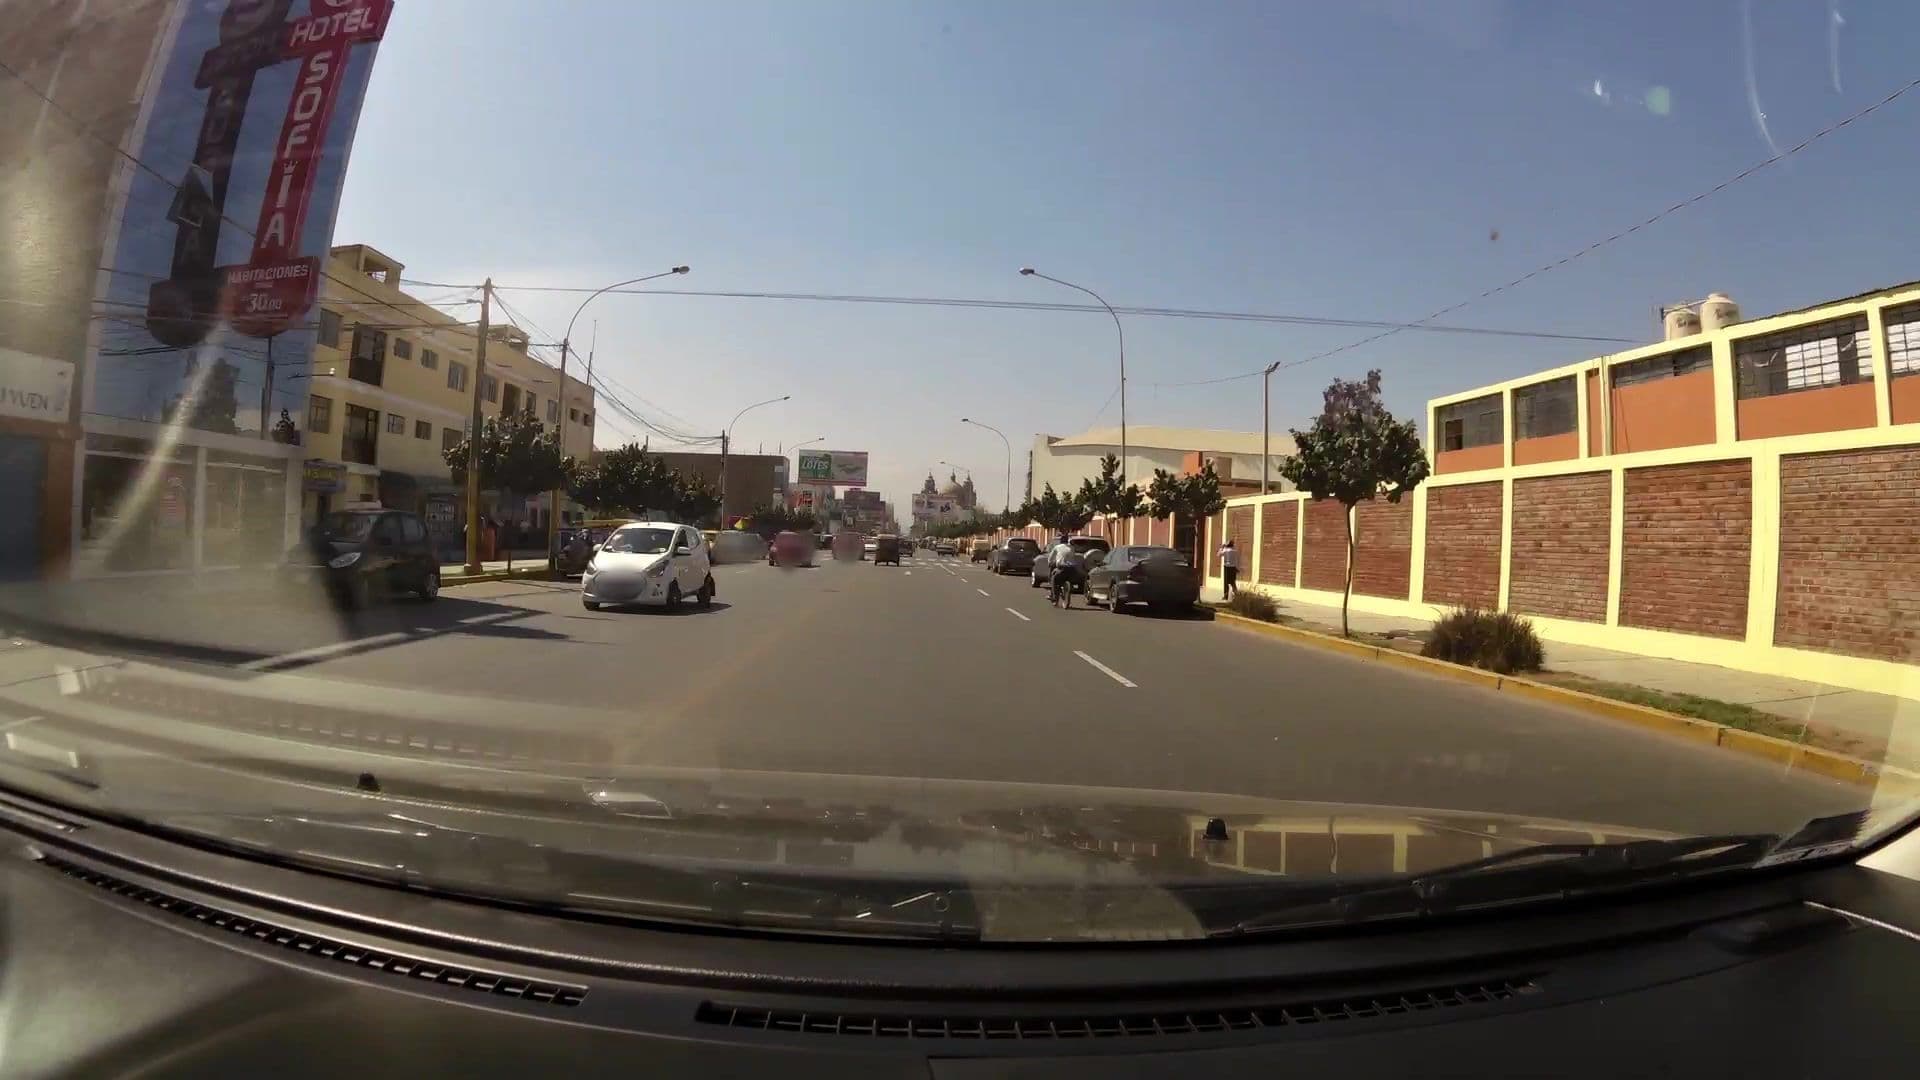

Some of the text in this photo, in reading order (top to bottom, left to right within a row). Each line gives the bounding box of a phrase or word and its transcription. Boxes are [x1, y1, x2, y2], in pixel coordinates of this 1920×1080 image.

[289, 7, 375, 47] HOTEL
[261, 51, 333, 249] SOFIA
[227, 264, 308, 286] HABITACIONES
